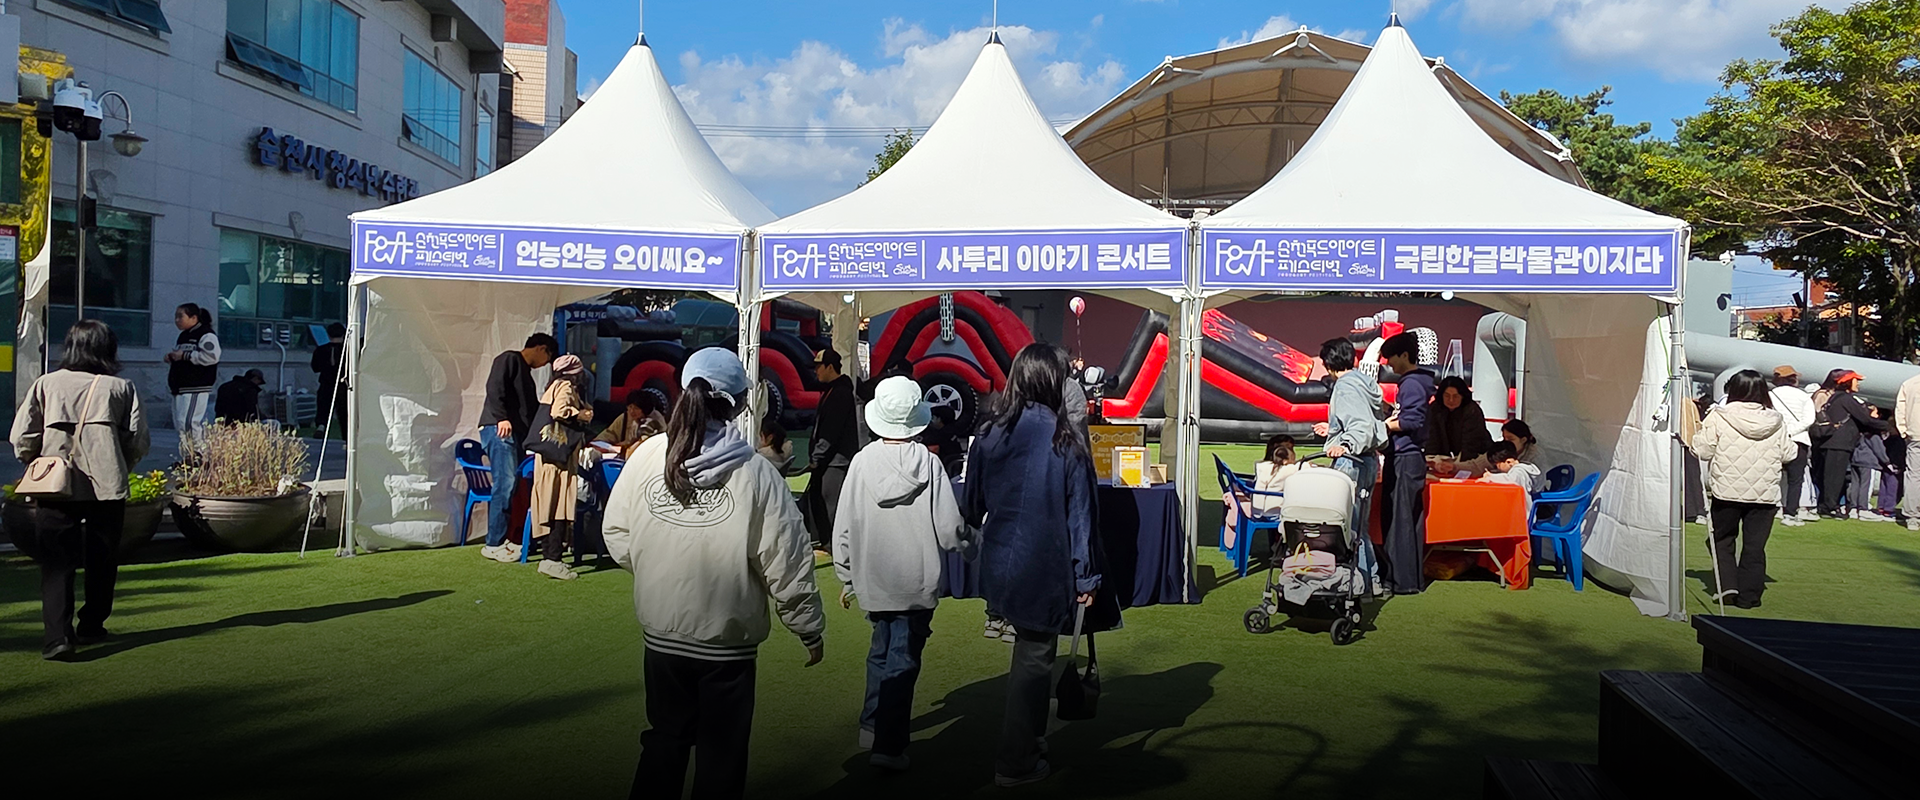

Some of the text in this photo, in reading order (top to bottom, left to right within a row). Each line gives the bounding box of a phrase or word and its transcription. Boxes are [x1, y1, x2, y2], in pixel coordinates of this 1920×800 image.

[257, 127, 326, 180] 순천시
[328, 150, 382, 197] 청소년
[415, 250, 470, 268] 페스티벌
[516, 240, 607, 271] 언능언능
[612, 244, 724, 274] 오이씨요~
[829, 261, 889, 278] 페스티벌
[936, 243, 1171, 273] 사투리 이야기 콘서트
[1277, 259, 1343, 277] 페스티벌
[1394, 244, 1664, 275] 국립한글박물관이지라
